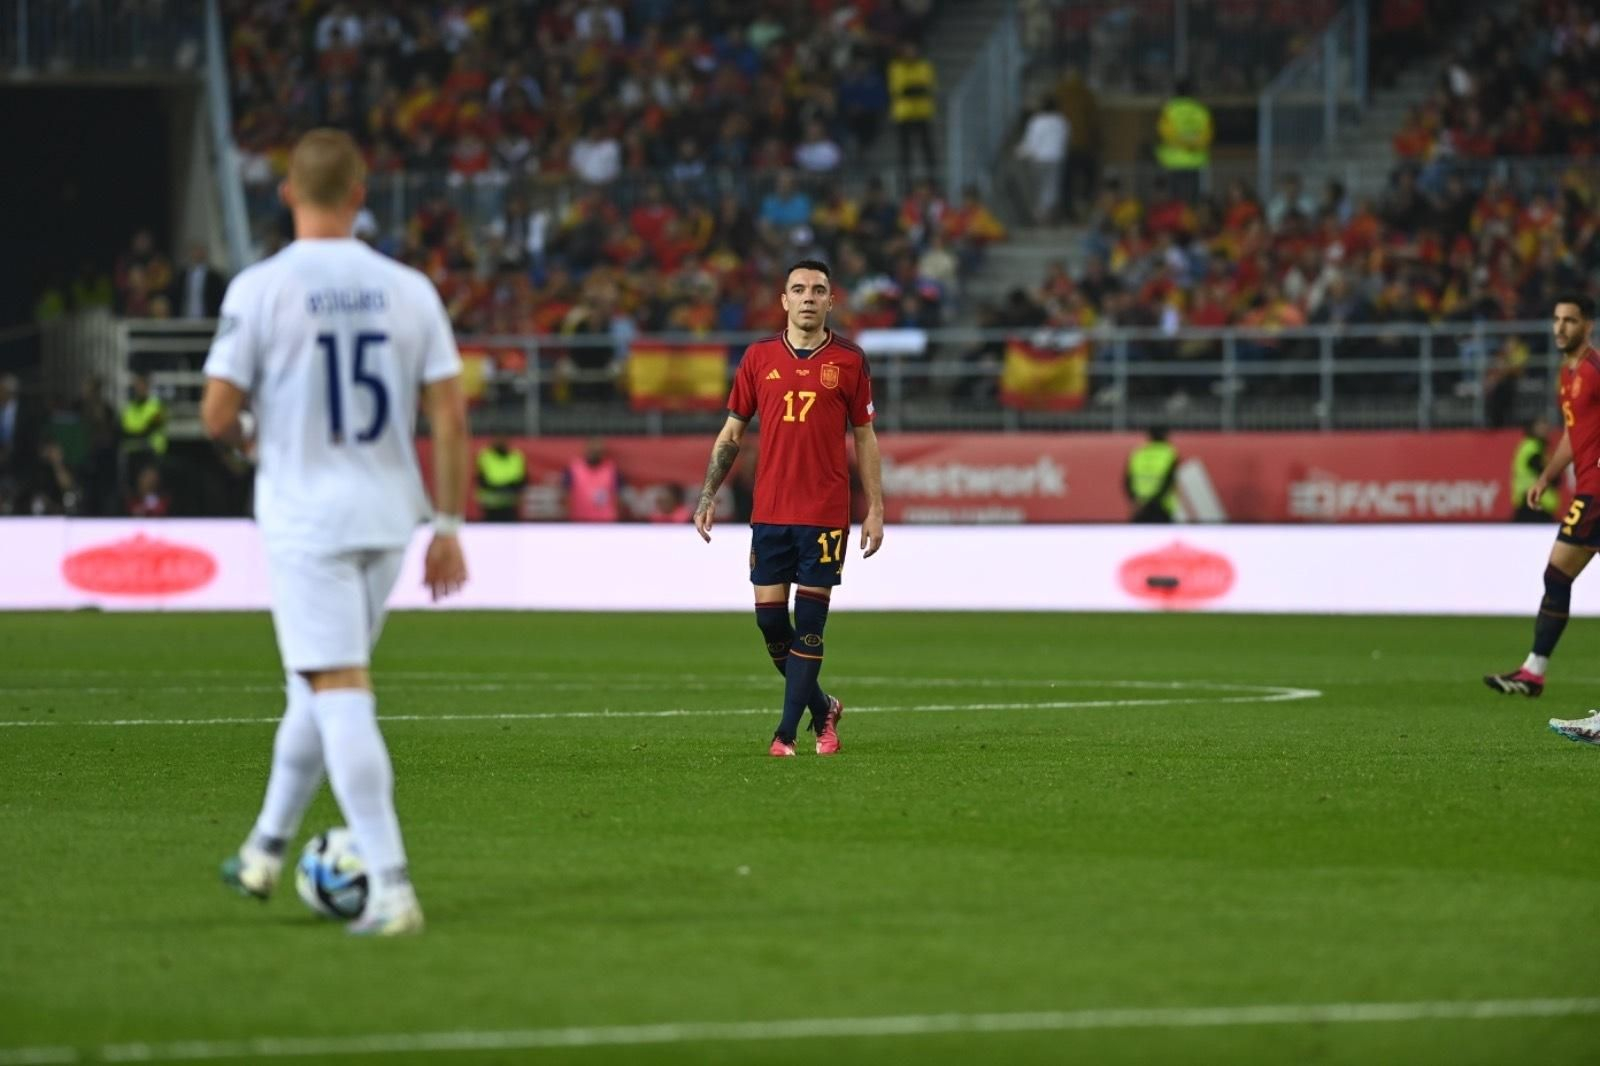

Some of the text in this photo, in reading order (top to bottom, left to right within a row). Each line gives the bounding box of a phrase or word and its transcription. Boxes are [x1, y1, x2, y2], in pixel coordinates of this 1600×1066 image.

[316, 331, 389, 444] 15
[783, 390, 817, 422] 17
[881, 455, 1067, 497] inetwork
[817, 529, 843, 563] 17
